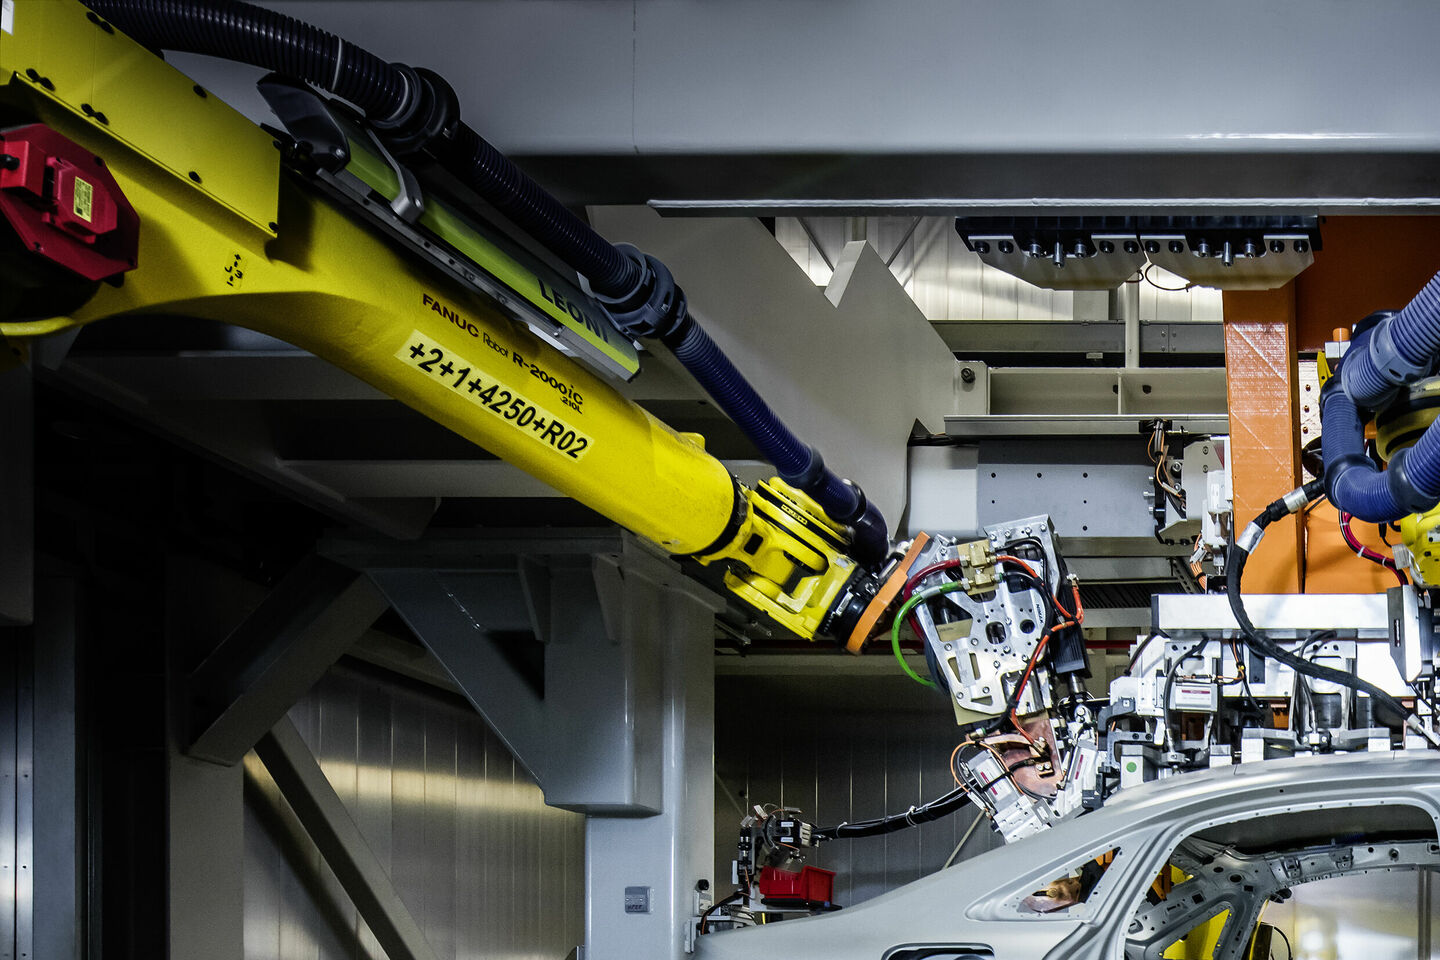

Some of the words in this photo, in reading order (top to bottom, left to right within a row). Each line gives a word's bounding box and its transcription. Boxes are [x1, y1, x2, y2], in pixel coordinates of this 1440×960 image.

[422, 293, 479, 338] FANUC
[482, 332, 509, 358] Robot
[512, 351, 584, 406] R-2000iC
[537, 278, 610, 344] LEONI
[409, 342, 588, 459] +2+1+4250+R02
[562, 397, 583, 415] 210L
